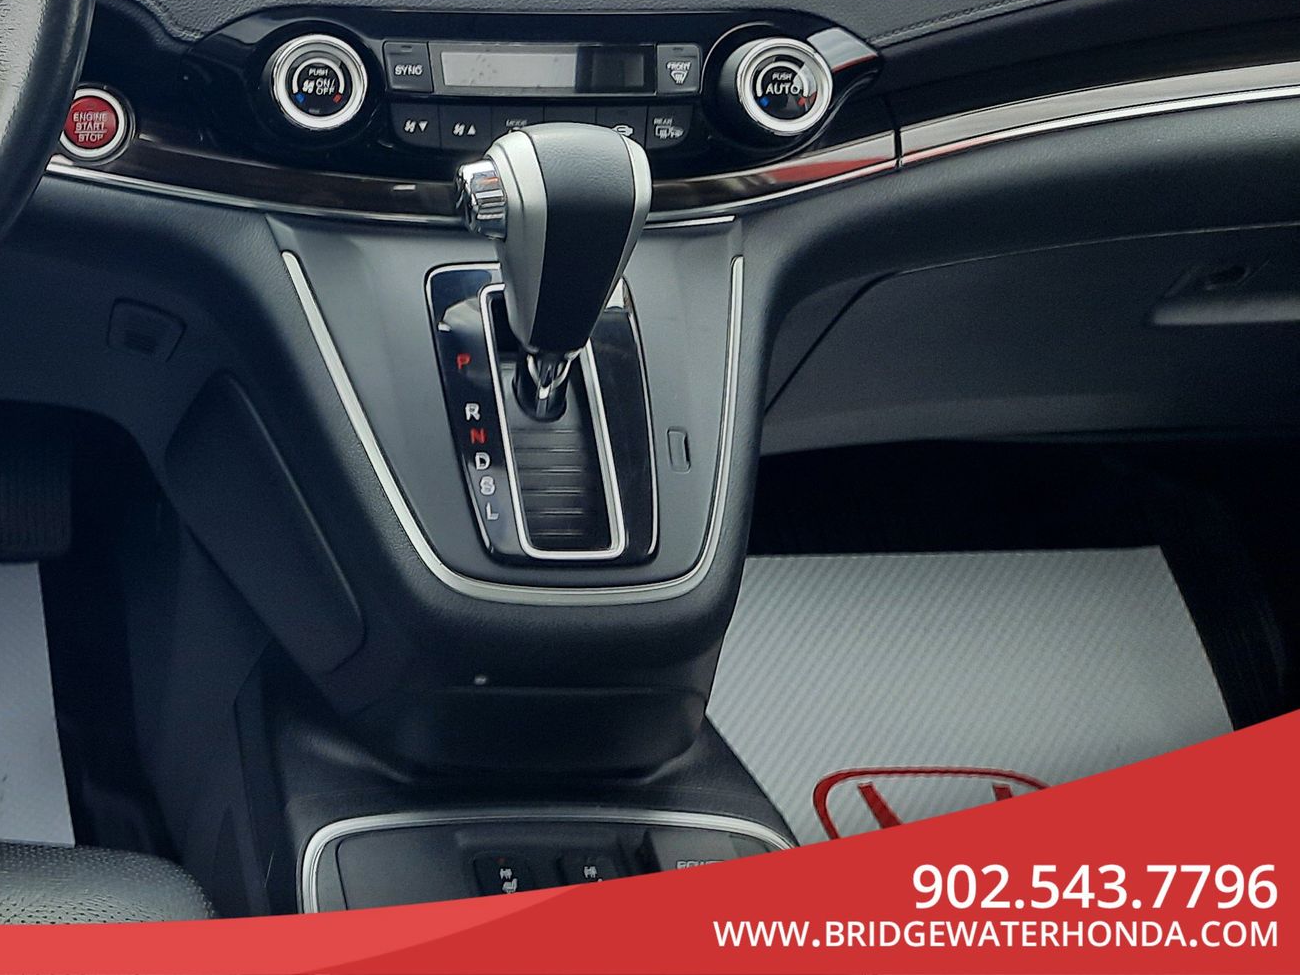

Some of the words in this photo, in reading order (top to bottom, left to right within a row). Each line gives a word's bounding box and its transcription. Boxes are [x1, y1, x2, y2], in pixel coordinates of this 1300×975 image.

[308, 68, 330, 76] PUSH
[394, 65, 423, 76] SYNC
[772, 72, 792, 81] PUSH
[315, 87, 335, 96] OFF
[765, 82, 802, 95] AUTO
[73, 111, 109, 122] ENGINE
[75, 122, 106, 131] START
[78, 133, 104, 142] STOP
[456, 353, 471, 369] P
[465, 403, 481, 421] R
[470, 429, 487, 444] N
[475, 451, 491, 471] D
[480, 476, 496, 495] S
[485, 503, 499, 521] L
